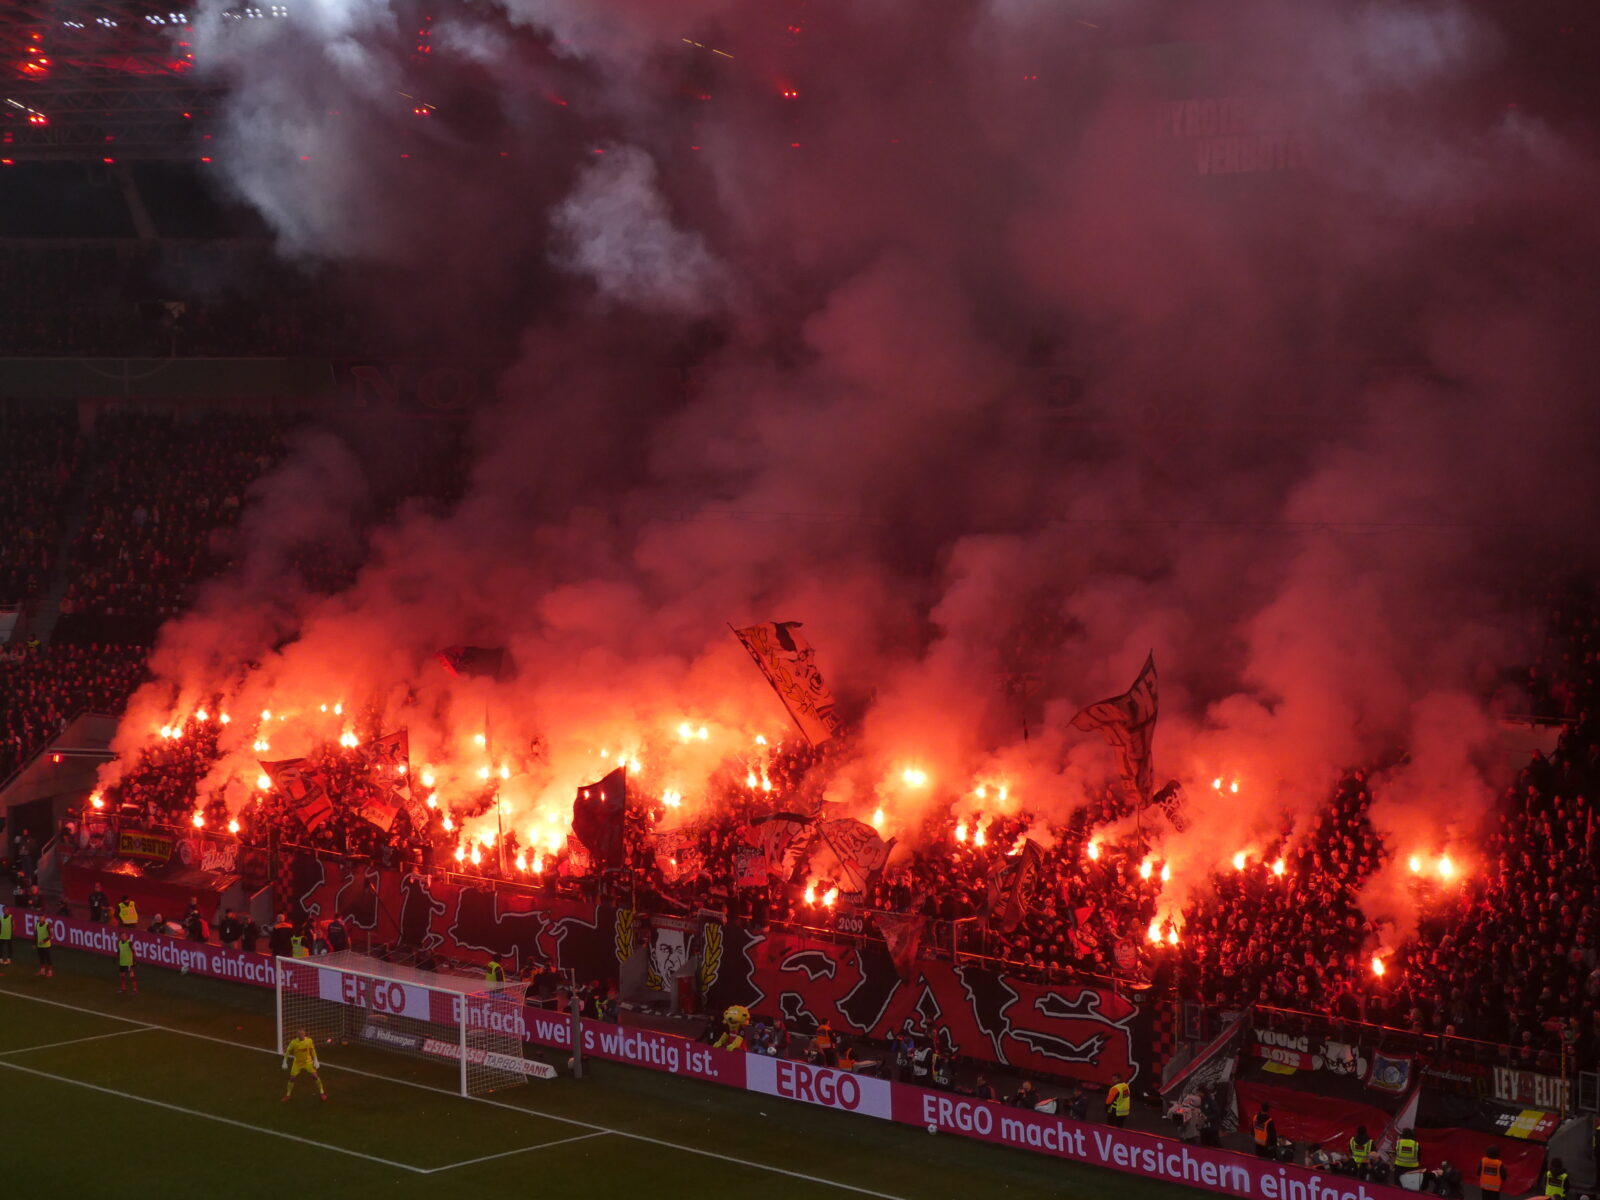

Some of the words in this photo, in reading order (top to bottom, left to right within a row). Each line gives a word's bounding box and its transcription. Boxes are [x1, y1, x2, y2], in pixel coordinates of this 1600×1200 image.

[24, 914, 66, 942] EO
[69, 927, 118, 953] macht
[129, 934, 207, 972] ersichern
[838, 917, 863, 933] 2009
[341, 971, 406, 1014] ERGO
[600, 1027, 679, 1073] wichtig
[686, 1042, 719, 1077] ist.
[1493, 1066, 1520, 1101] LEV
[1534, 1074, 1570, 1111] ELITE
[776, 1061, 860, 1110] ERGO
[923, 1094, 993, 1135] ERGO
[1001, 1117, 1086, 1158] macht
[1094, 1131, 1251, 1193] Versichern
